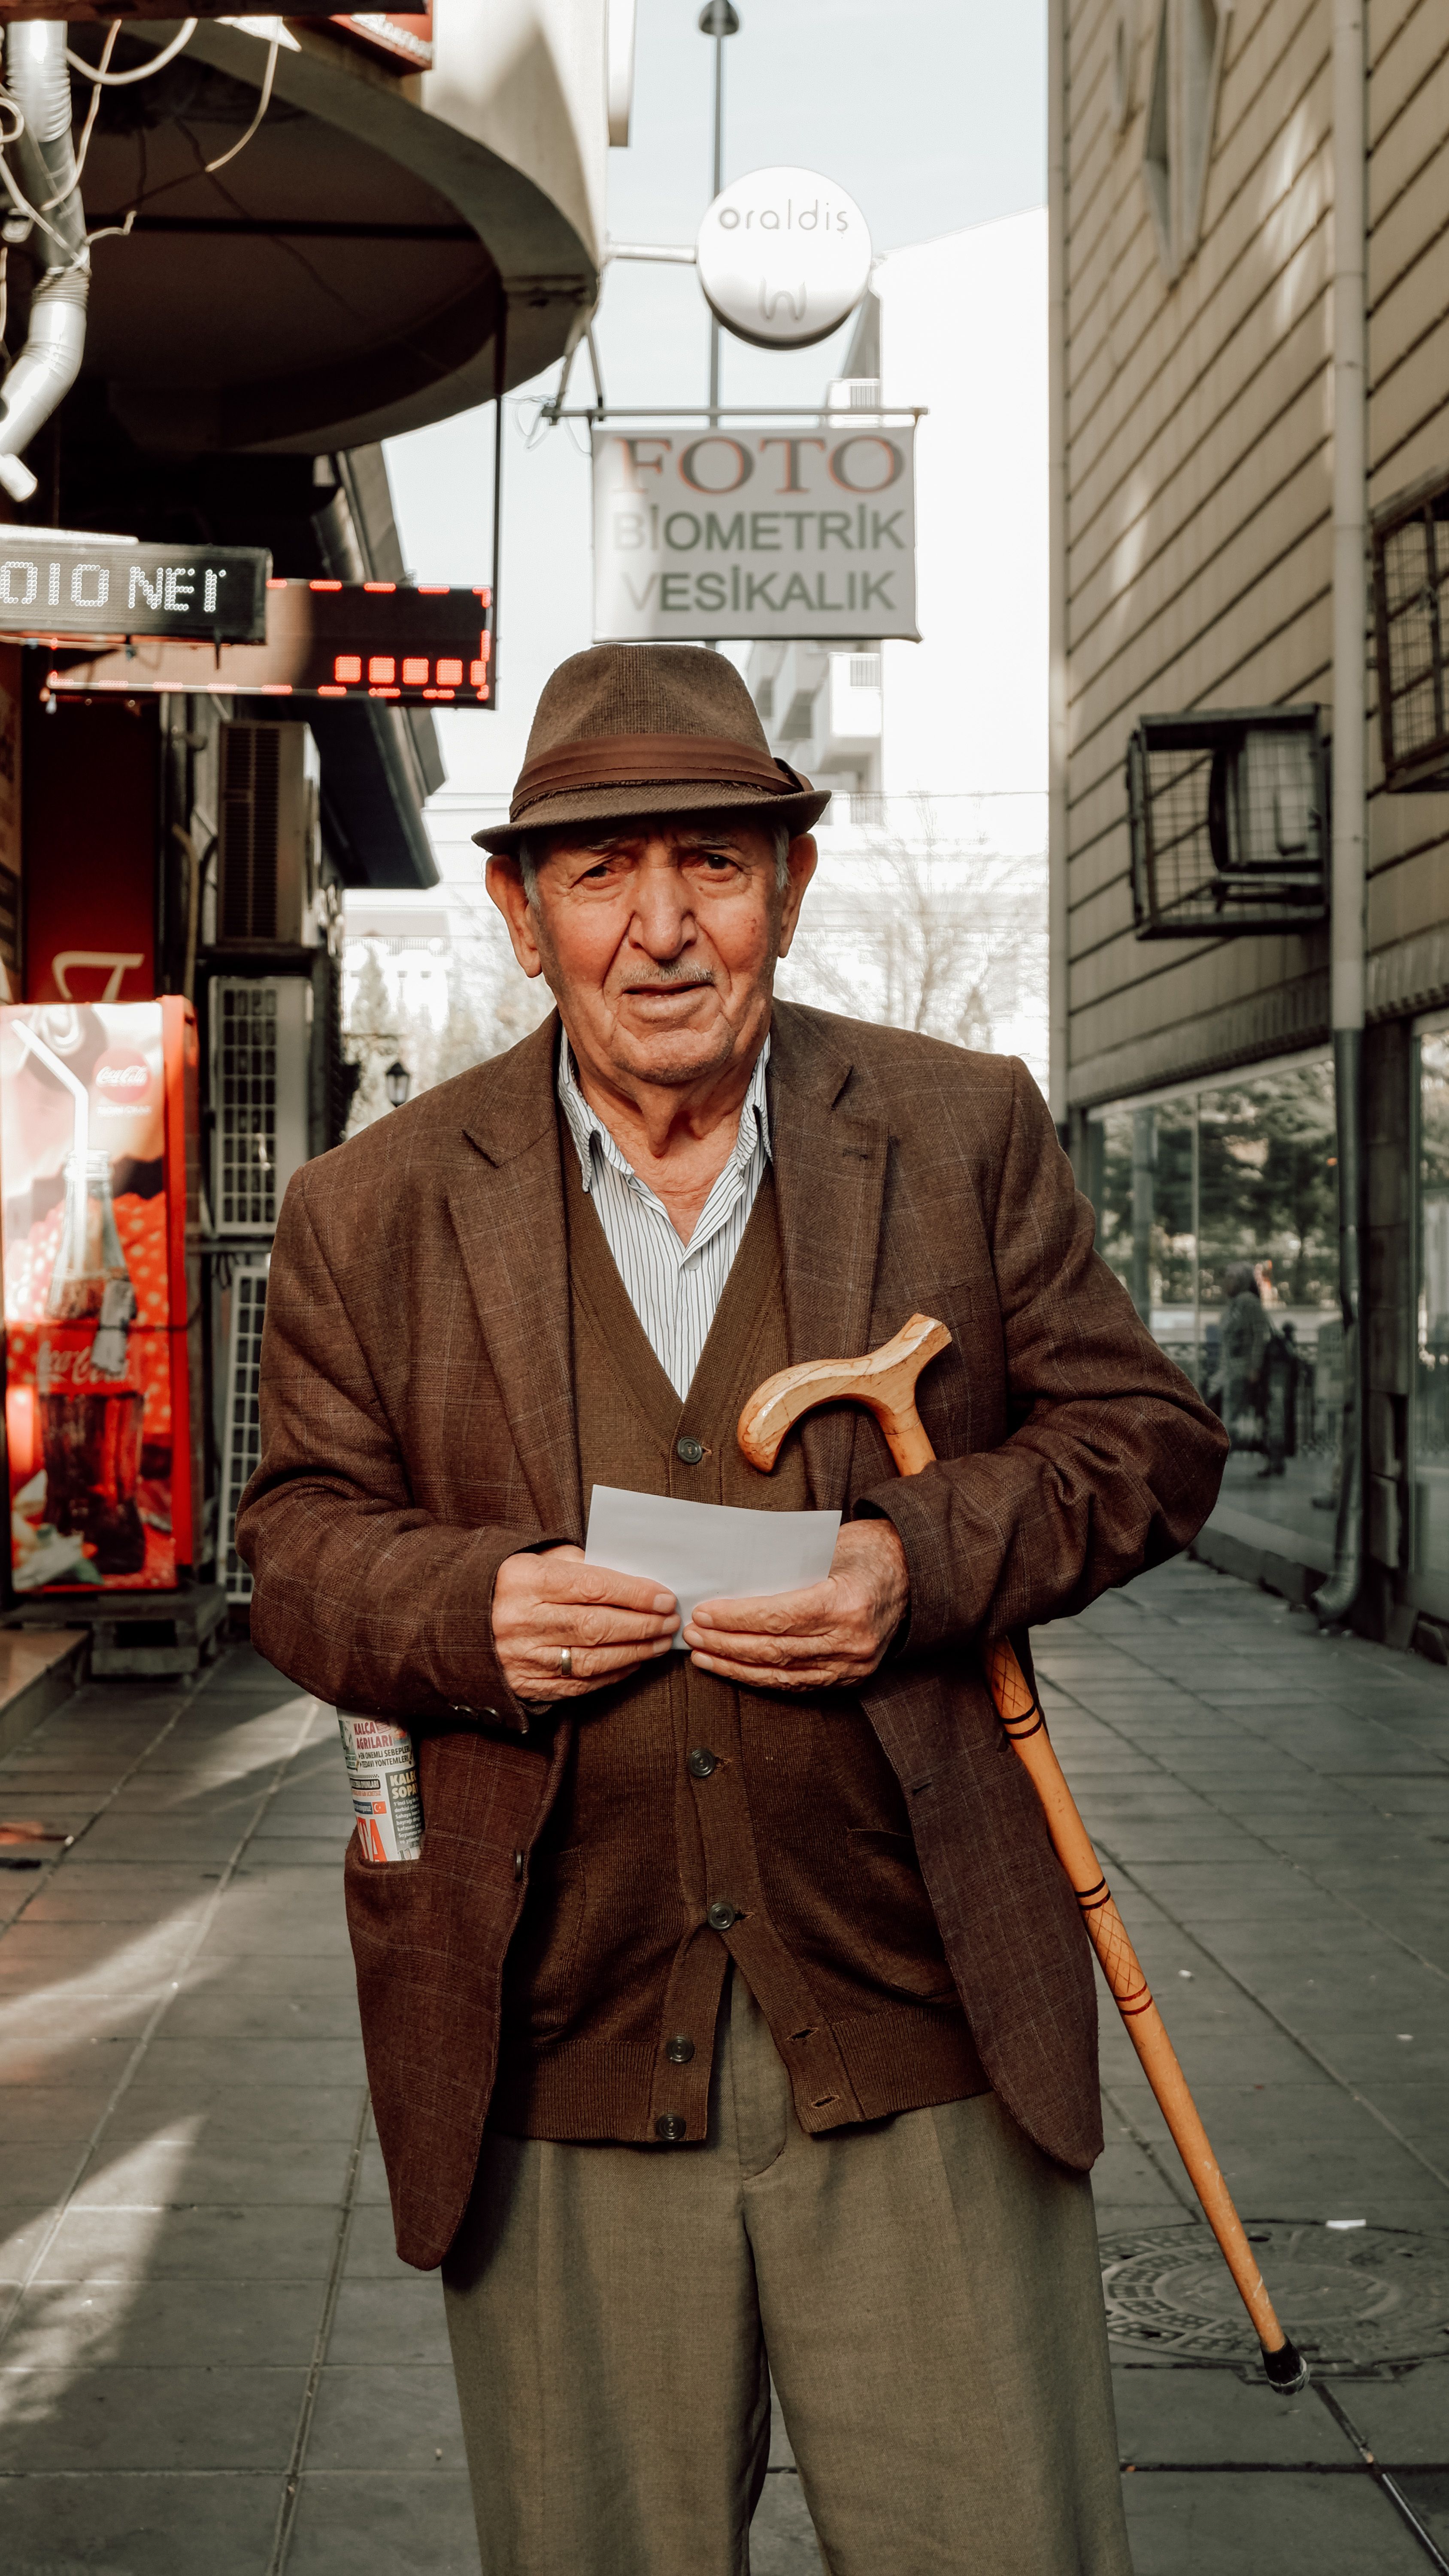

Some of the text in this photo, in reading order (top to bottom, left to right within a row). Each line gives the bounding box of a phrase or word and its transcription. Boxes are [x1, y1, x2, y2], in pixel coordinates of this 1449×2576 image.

[719, 198, 849, 233] oraldis
[613, 434, 905, 495] FOTO
[615, 503, 906, 551] BİOMETRİK
[623, 565, 897, 612] VESİKALIK
[354, 1722, 376, 1735] KALÇA
[357, 1735, 393, 1750] AĞRILARI
[390, 1770, 416, 1787] KALE
[391, 1783, 418, 1799] SOPA
